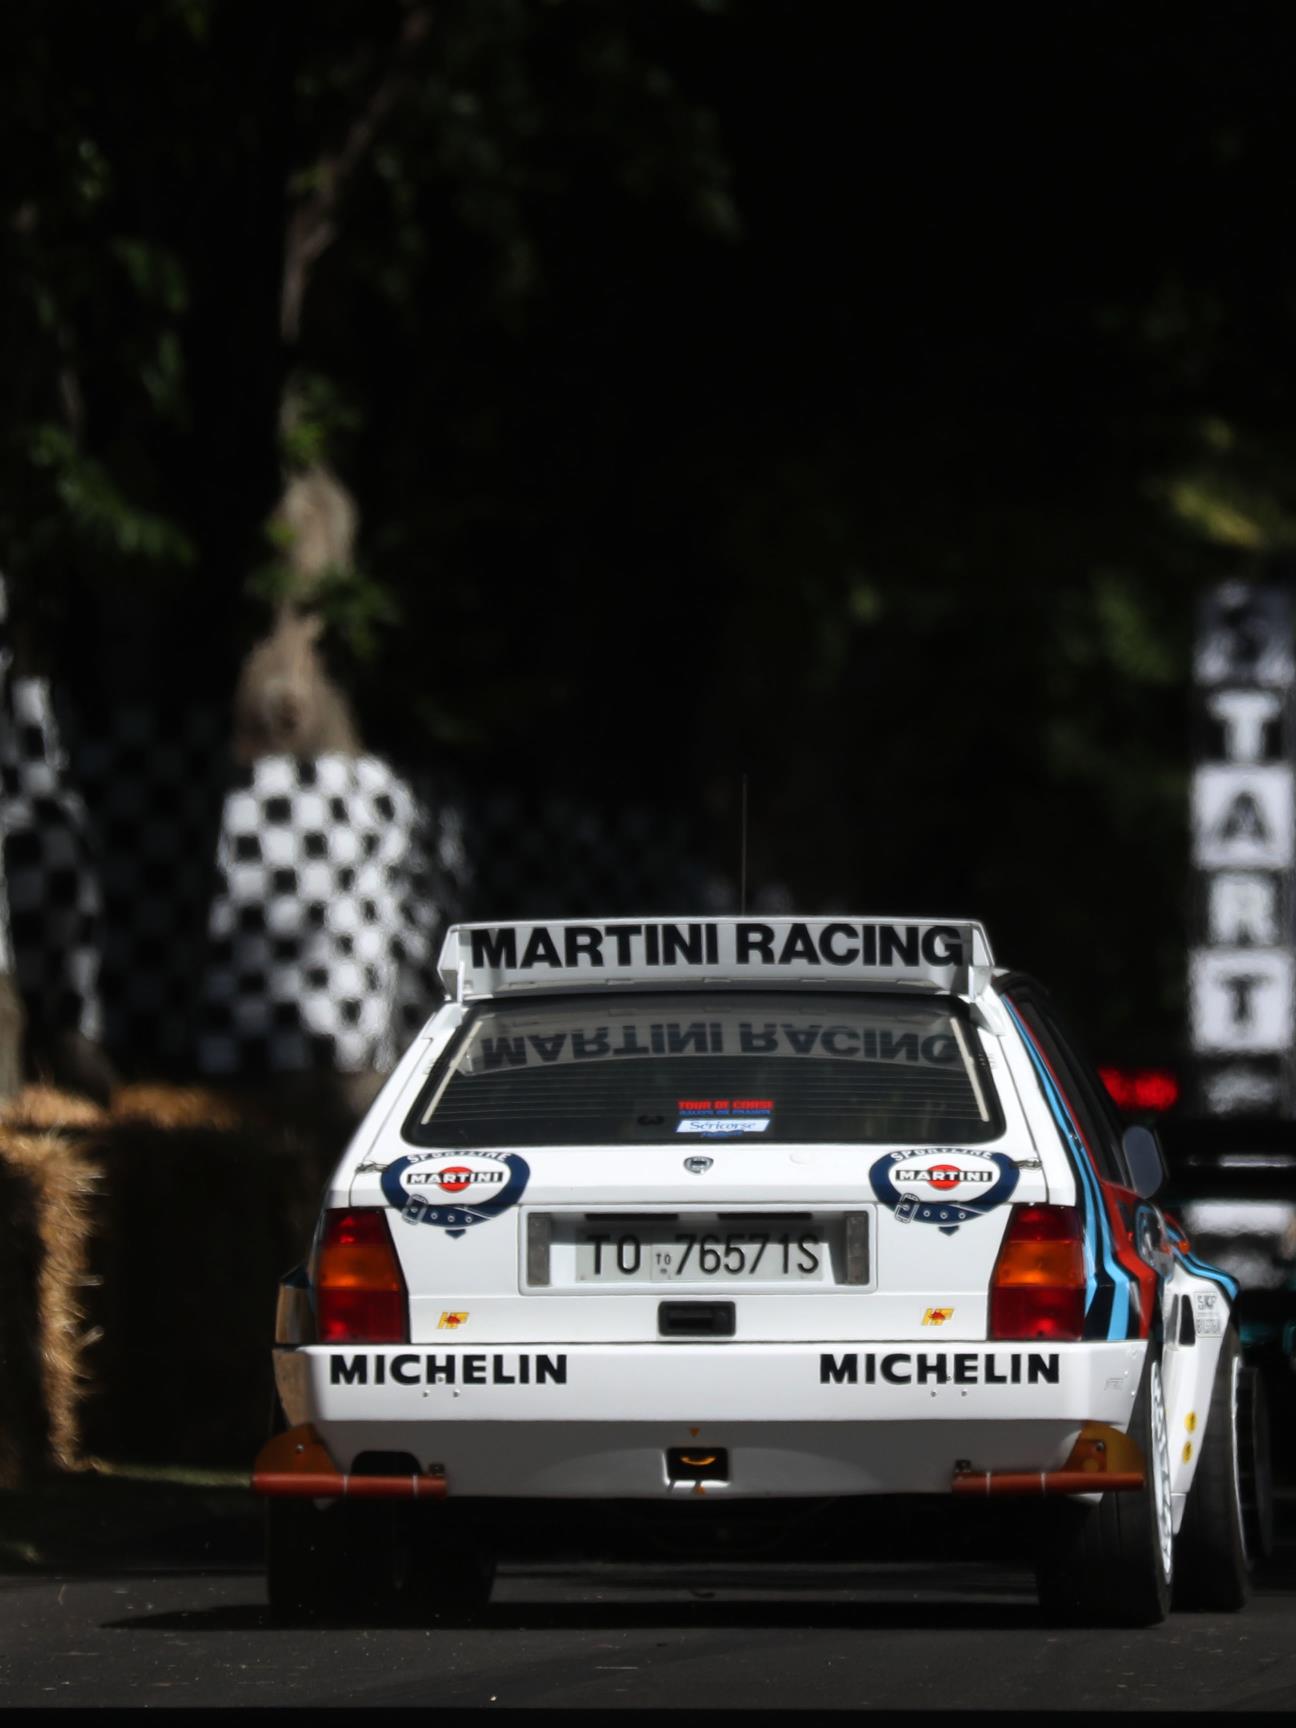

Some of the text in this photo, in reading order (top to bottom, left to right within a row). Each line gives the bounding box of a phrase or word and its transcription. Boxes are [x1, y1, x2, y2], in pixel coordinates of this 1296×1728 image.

[470, 922, 964, 969] MARTINI RACING
[406, 1150, 511, 1164] SPORTLINE
[890, 1148, 993, 1162] SPORTLINE
[410, 1171, 500, 1185] MARTINI
[899, 1170, 989, 1183] MARTINI
[587, 1232, 820, 1276] TO 76571S
[330, 1354, 567, 1386] MICHELIN
[820, 1353, 1060, 1385] MICHELIN
